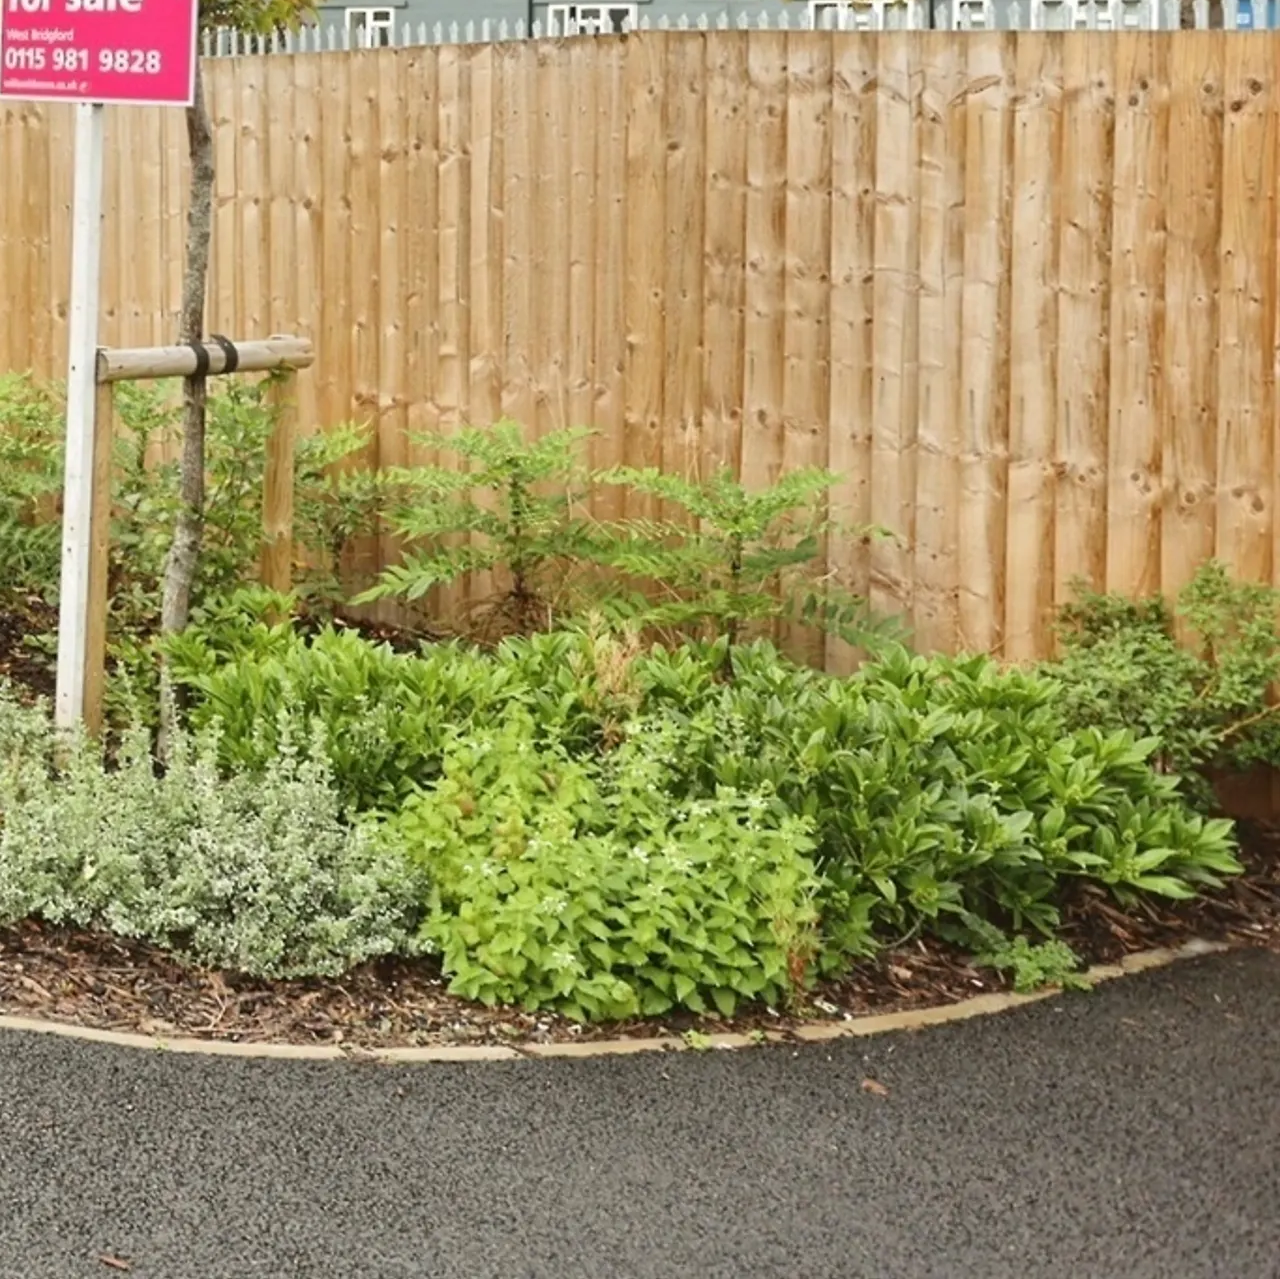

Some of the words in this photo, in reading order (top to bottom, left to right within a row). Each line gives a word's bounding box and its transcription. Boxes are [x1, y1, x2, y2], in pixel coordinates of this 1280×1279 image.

[5, 46, 46, 70] 0115
[52, 47, 89, 72] 981
[98, 48, 162, 75] 9828
